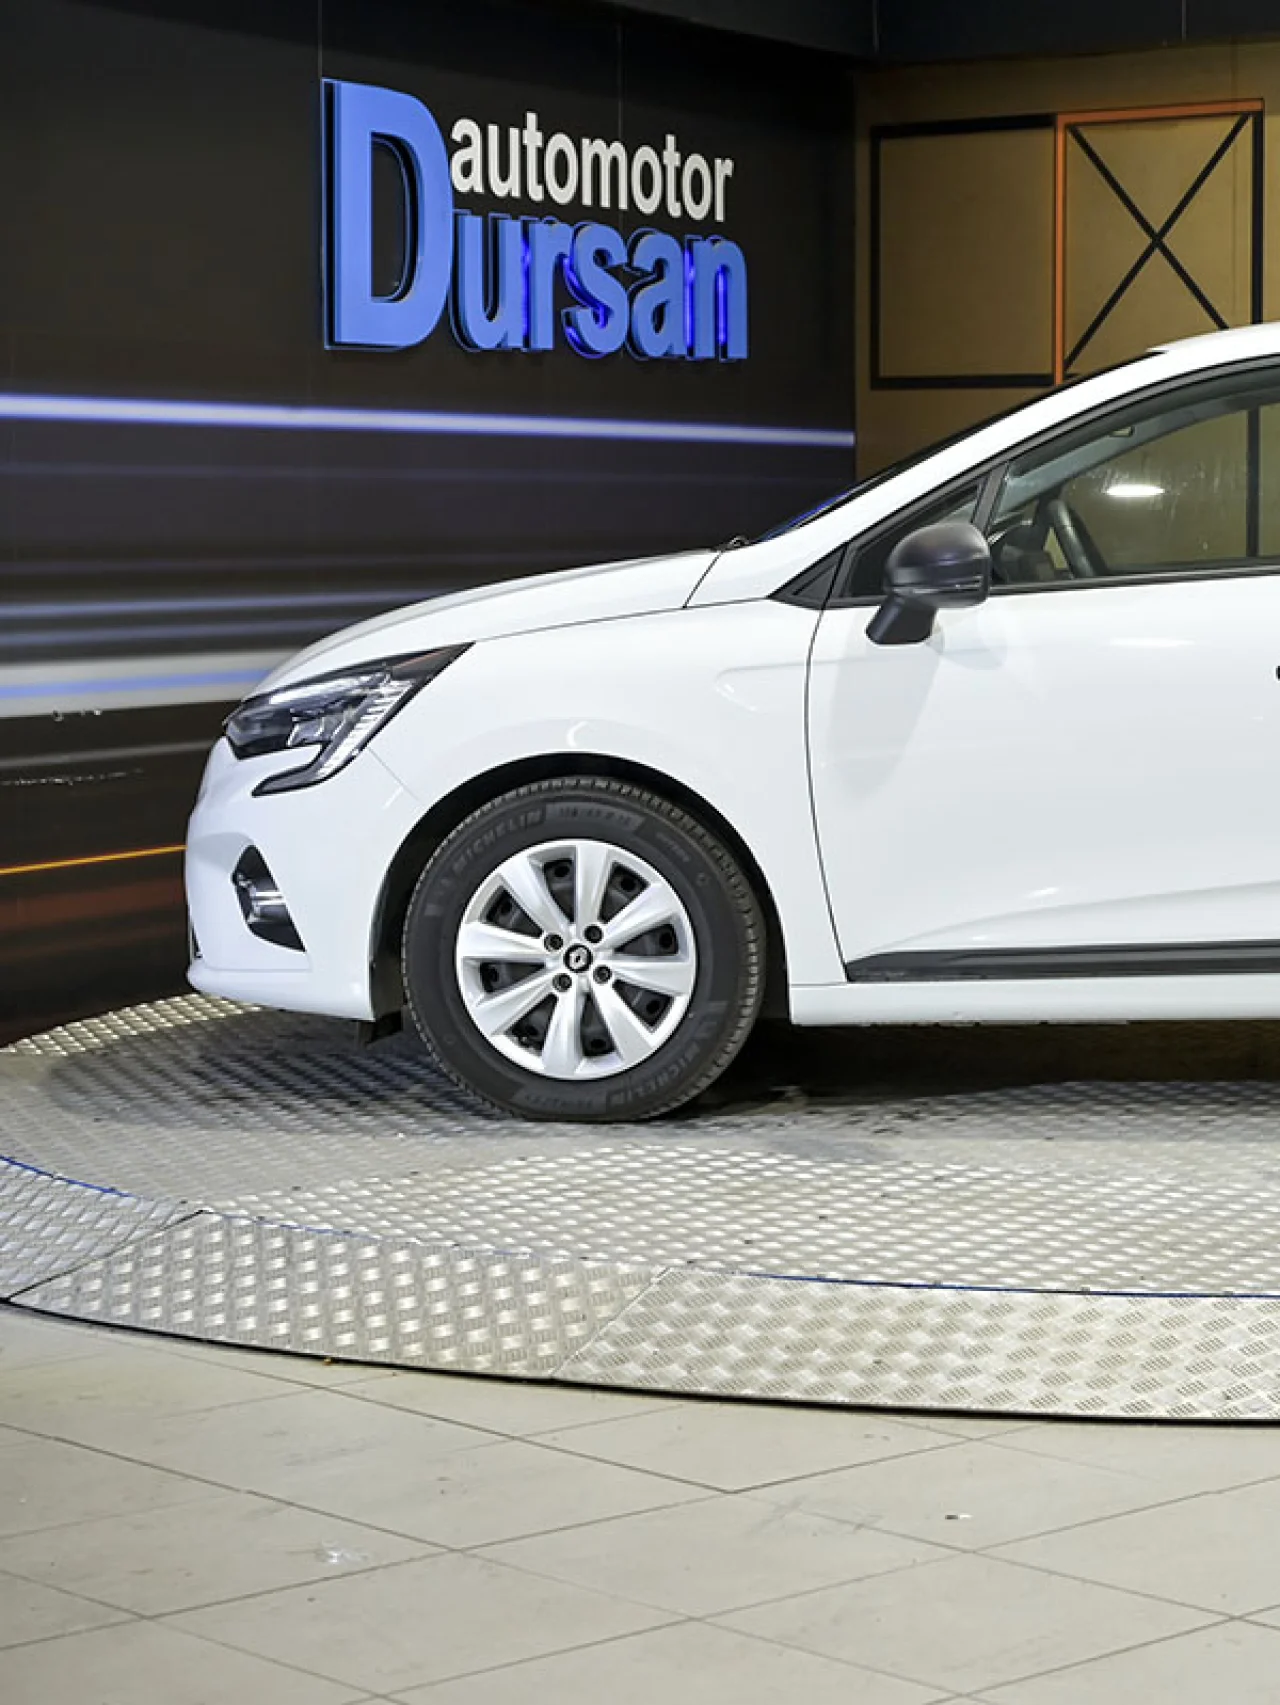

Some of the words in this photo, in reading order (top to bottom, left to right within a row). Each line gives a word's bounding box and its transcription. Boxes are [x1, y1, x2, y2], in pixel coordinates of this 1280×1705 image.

[322, 79, 748, 361] Dursan
[450, 111, 735, 222] automotor
[451, 807, 546, 875] MICHELIN
